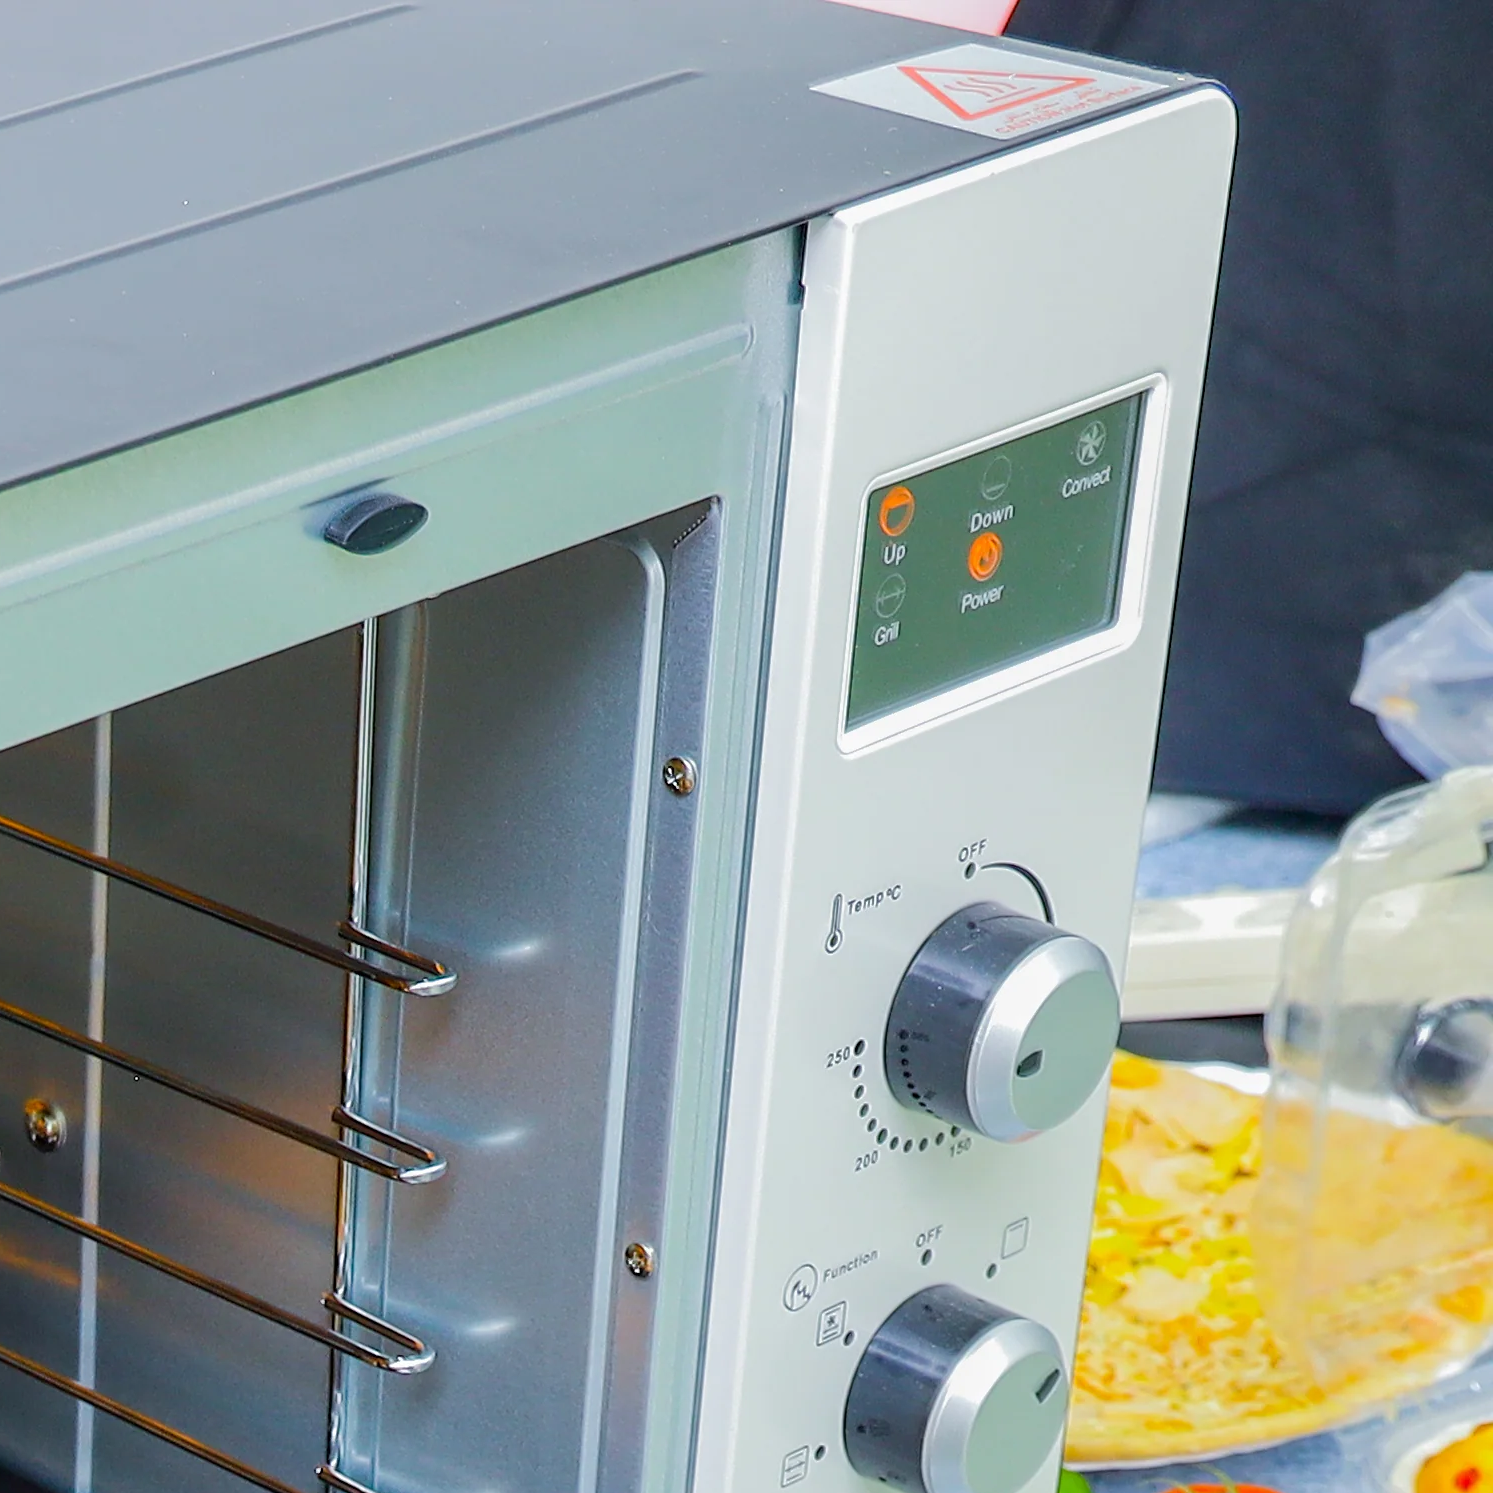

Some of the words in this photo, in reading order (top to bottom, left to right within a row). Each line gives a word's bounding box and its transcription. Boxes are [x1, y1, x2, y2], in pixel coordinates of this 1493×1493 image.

[1063, 465, 1111, 498] Convect
[970, 504, 1014, 533] Down
[883, 543, 906, 565] Up
[961, 585, 1005, 614] Power
[874, 621, 900, 646] Grill
[958, 838, 987, 862] OFF
[847, 891, 884, 915] Temp
[826, 1046, 851, 1068] 250
[950, 1137, 972, 1157] 150
[855, 1150, 879, 1172] 200
[916, 1224, 943, 1247] OFF
[823, 1250, 878, 1283] Function
